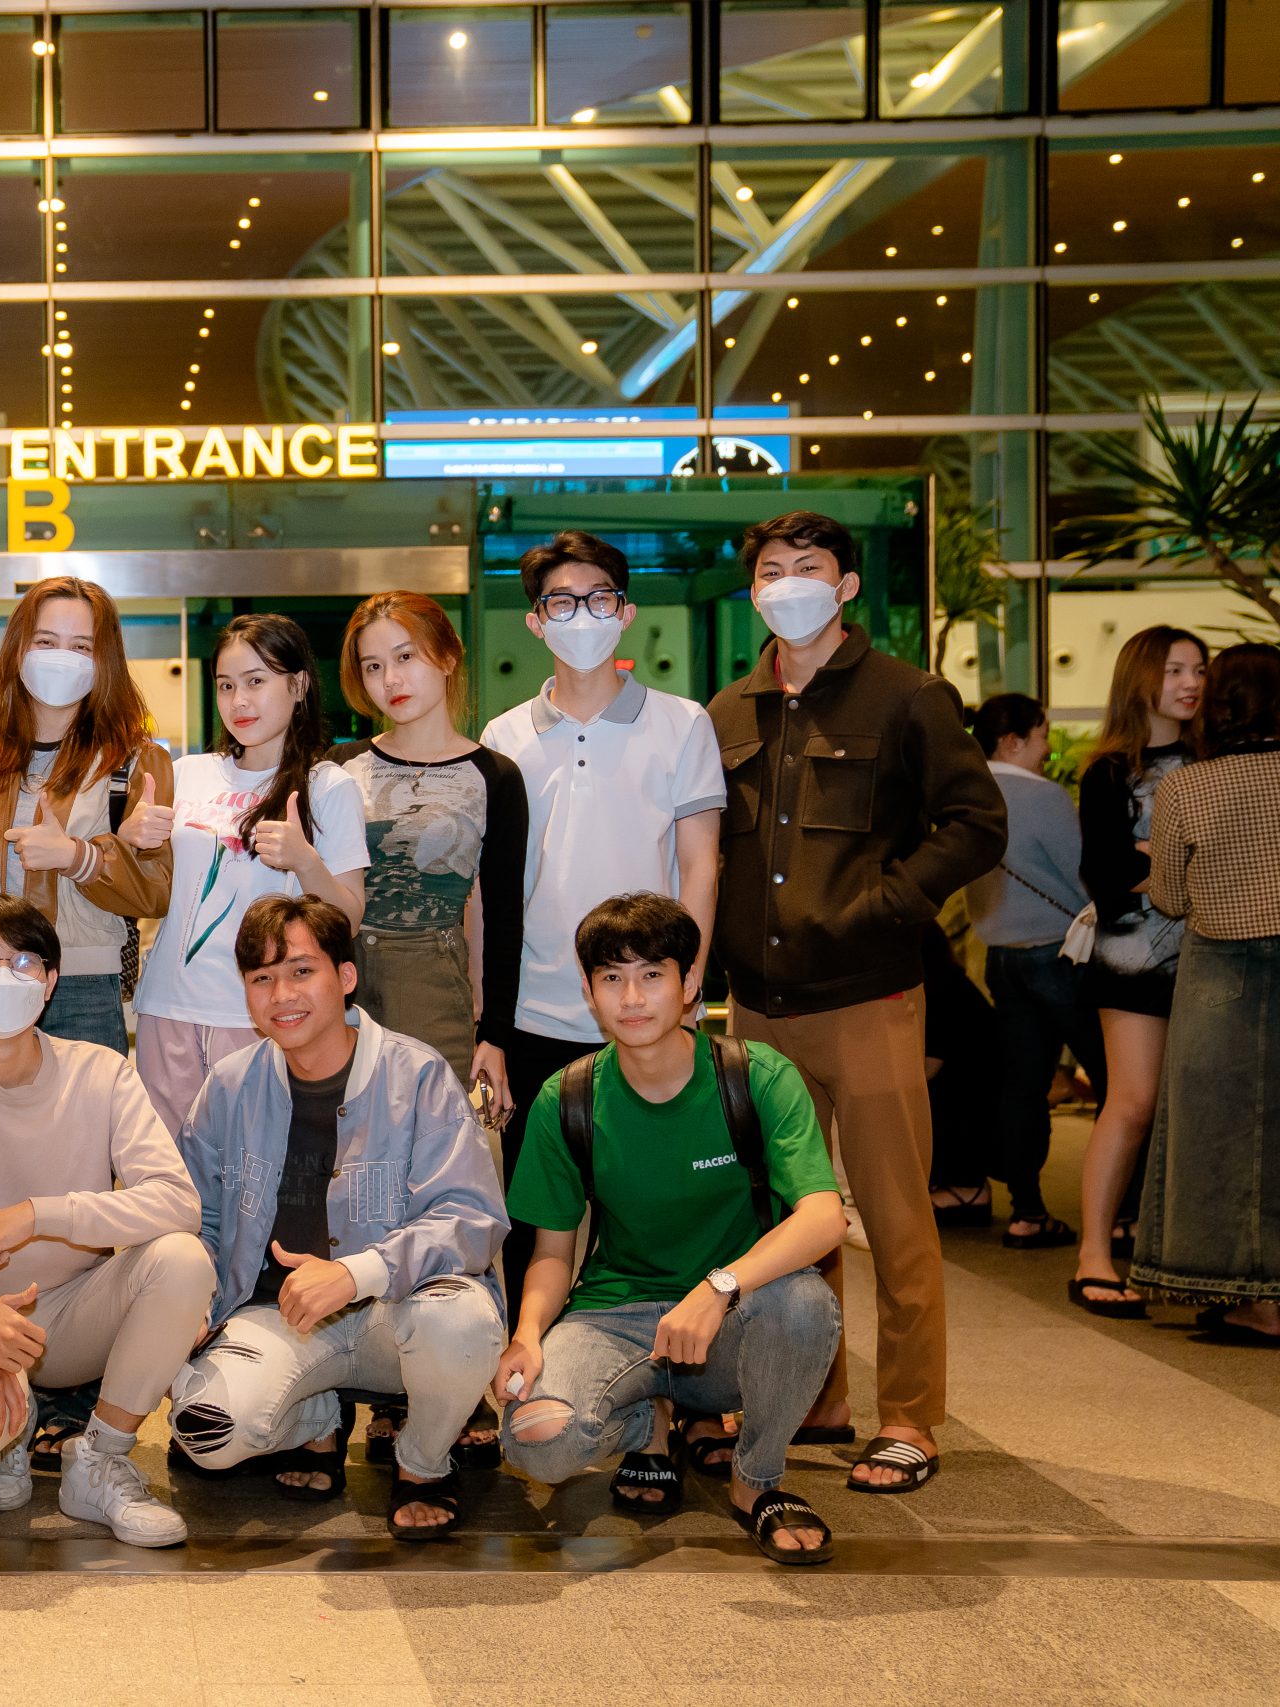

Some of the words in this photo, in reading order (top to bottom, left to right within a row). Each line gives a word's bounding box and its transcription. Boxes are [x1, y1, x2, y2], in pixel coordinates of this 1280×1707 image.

[11, 424, 378, 480] ENTRANCE
[7, 476, 75, 553] B
[692, 1152, 738, 1170] PEACEOU
[783, 1502, 817, 1516] FURT
